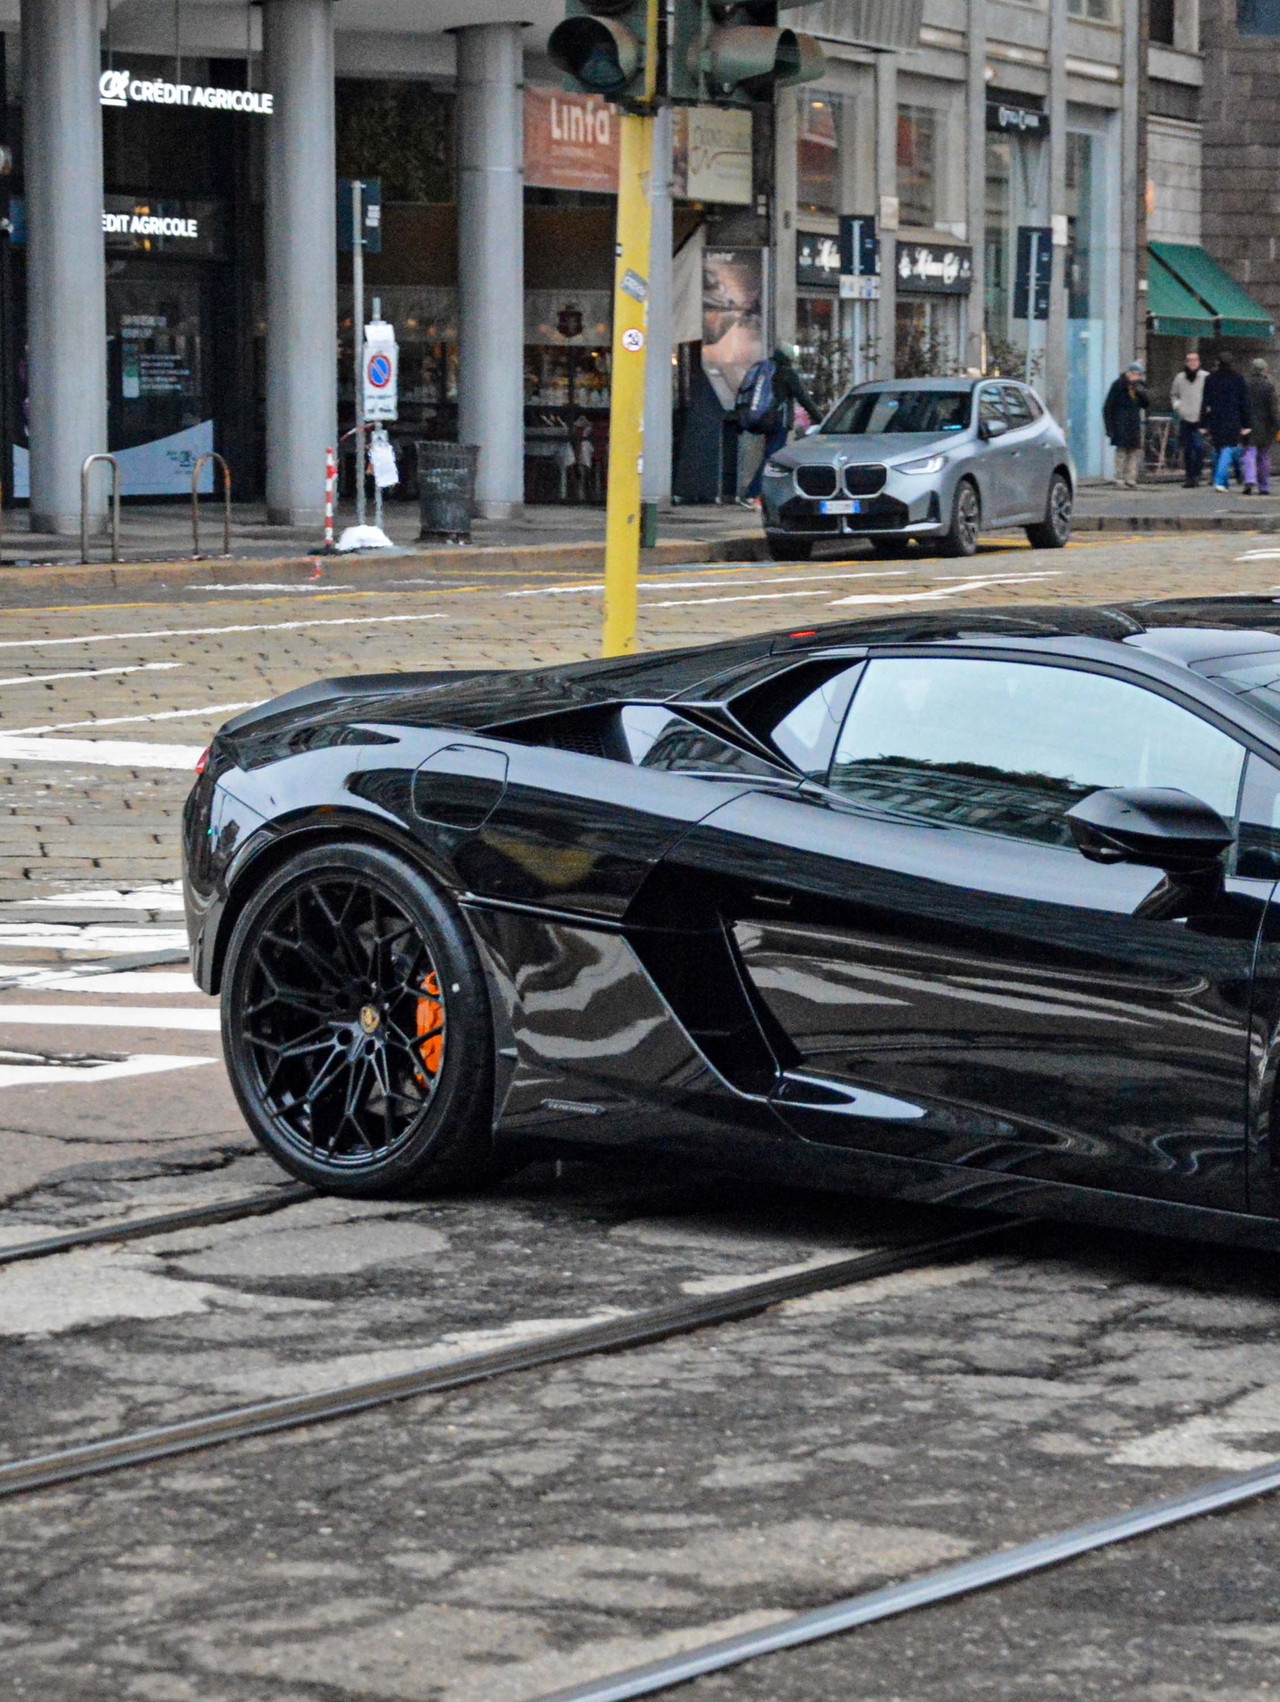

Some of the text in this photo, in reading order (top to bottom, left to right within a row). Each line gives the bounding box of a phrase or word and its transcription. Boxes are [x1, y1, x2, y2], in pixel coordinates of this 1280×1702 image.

[130, 78, 191, 106] CRÉDIT
[193, 86, 273, 114] AGRICOLE
[130, 215, 198, 237] AGRICOLE
